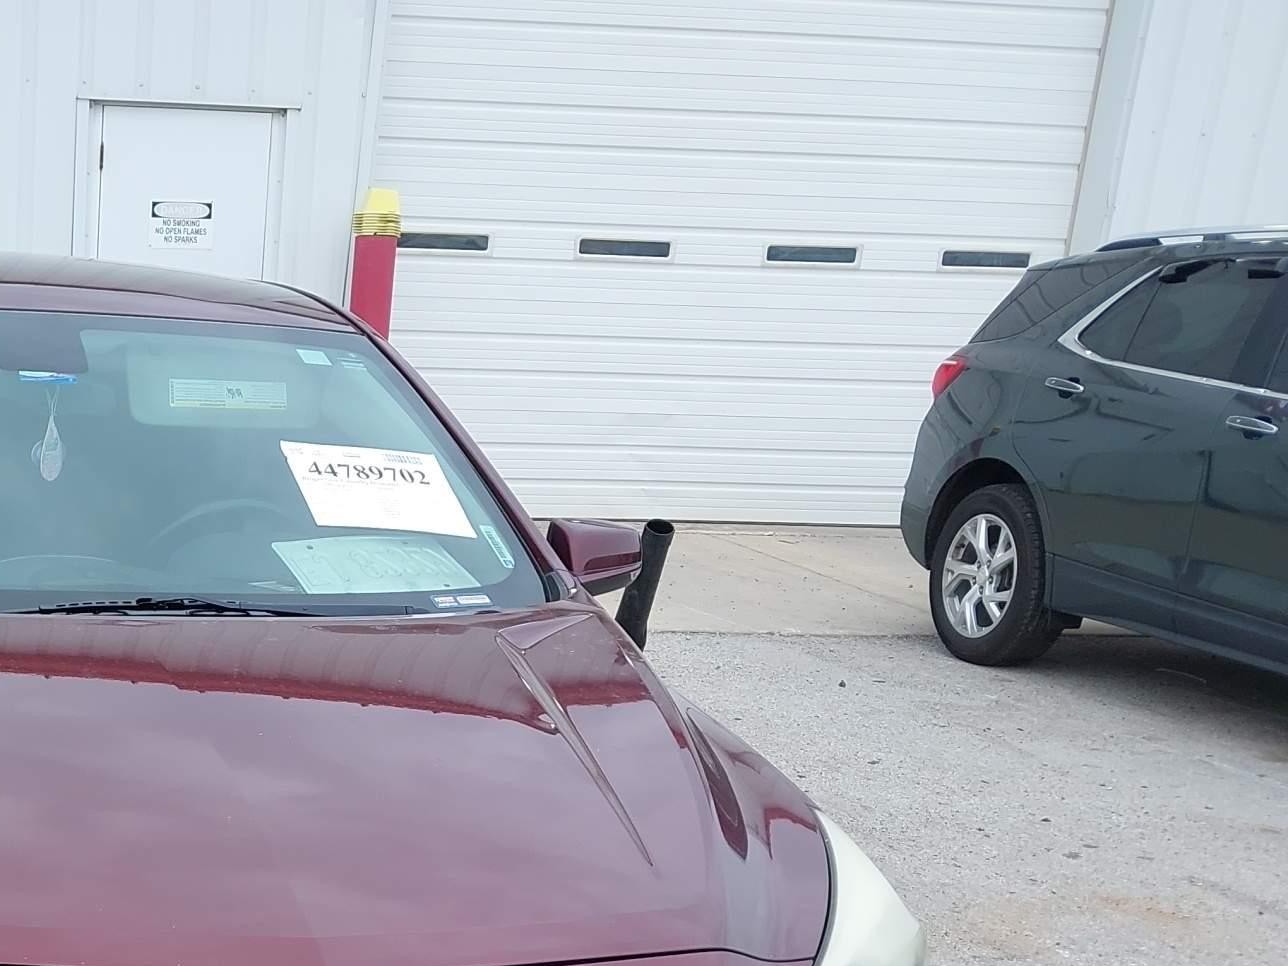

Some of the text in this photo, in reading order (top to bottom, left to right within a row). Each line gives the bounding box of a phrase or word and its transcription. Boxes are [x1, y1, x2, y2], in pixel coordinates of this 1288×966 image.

[173, 219, 200, 227] SMOKING
[155, 227, 164, 235] NO
[165, 227, 181, 235] OPEN
[308, 461, 430, 485] 44789702
